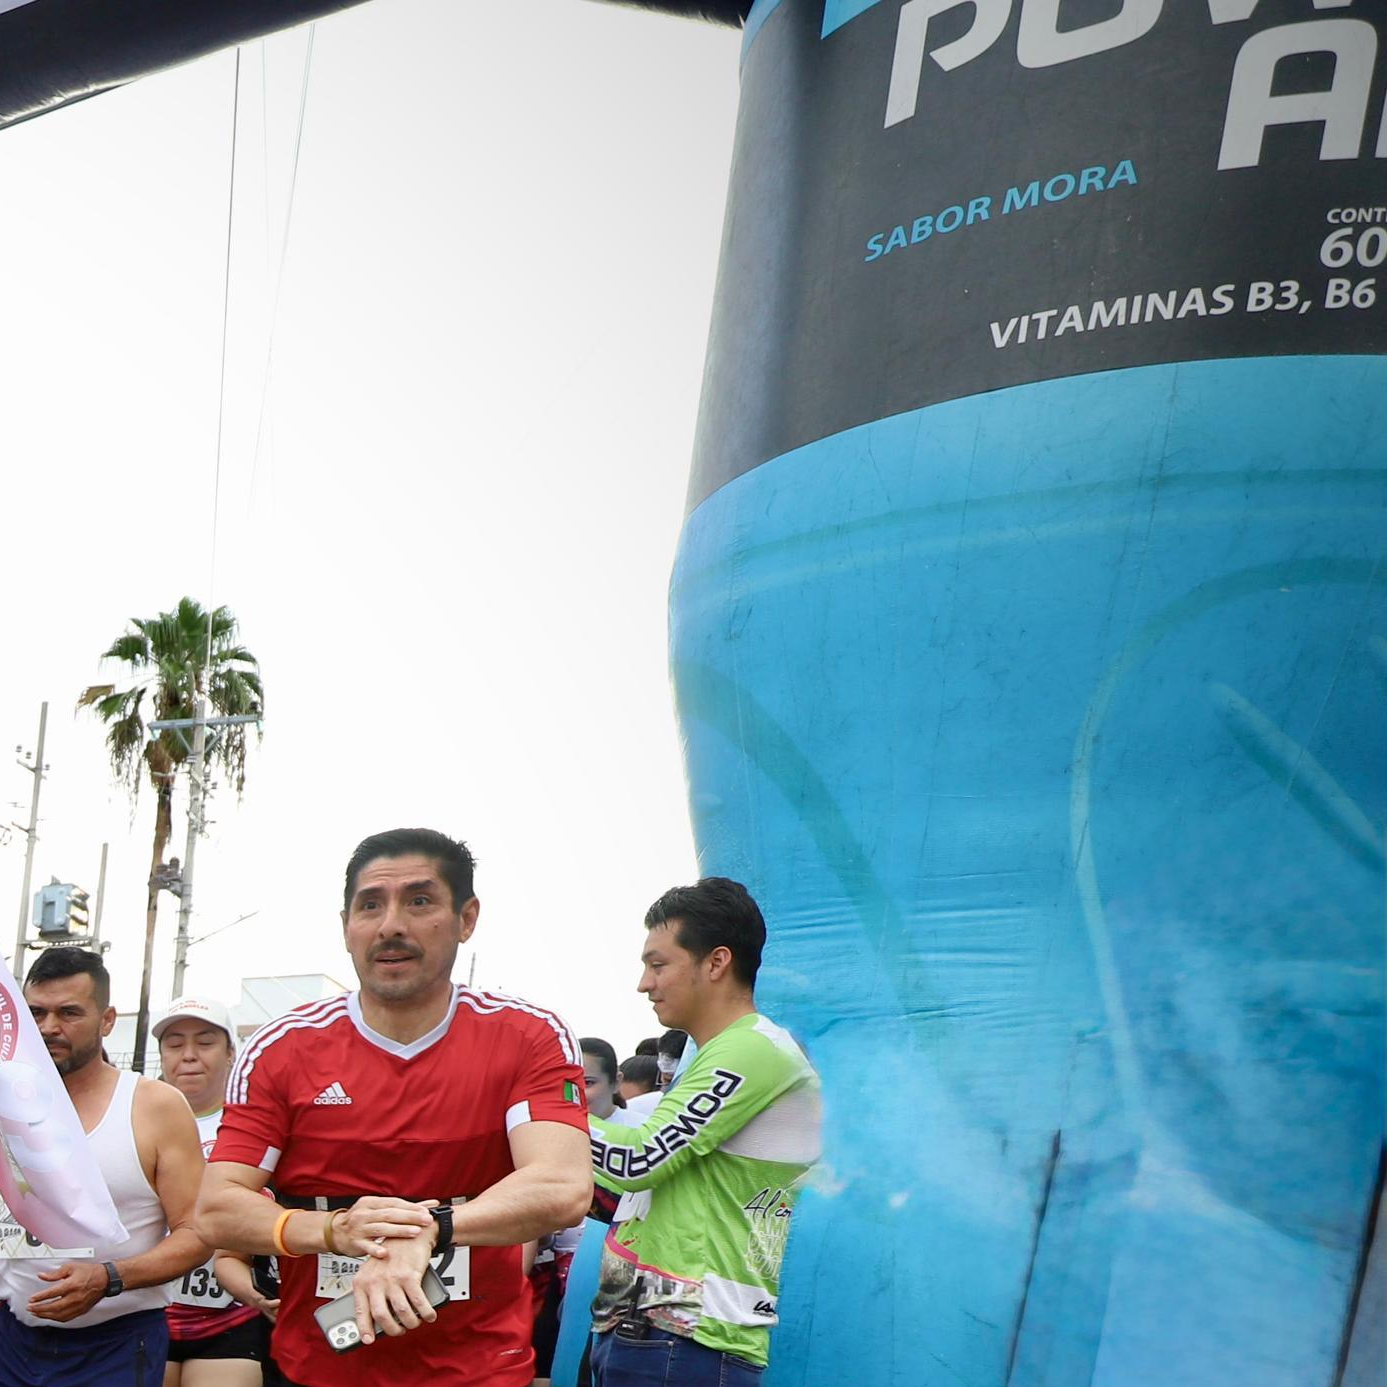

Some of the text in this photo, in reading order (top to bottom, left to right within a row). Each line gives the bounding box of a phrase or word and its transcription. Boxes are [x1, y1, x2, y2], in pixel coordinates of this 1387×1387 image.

[864, 159, 1138, 262] SABOR MORA
[1326, 207, 1387, 224] CONT
[989, 277, 1376, 349] VITAMINAS B3, B6
[1, 1013, 13, 1030] DE
[313, 1095, 352, 1105] adidas
[591, 1069, 743, 1178] POWERADE
